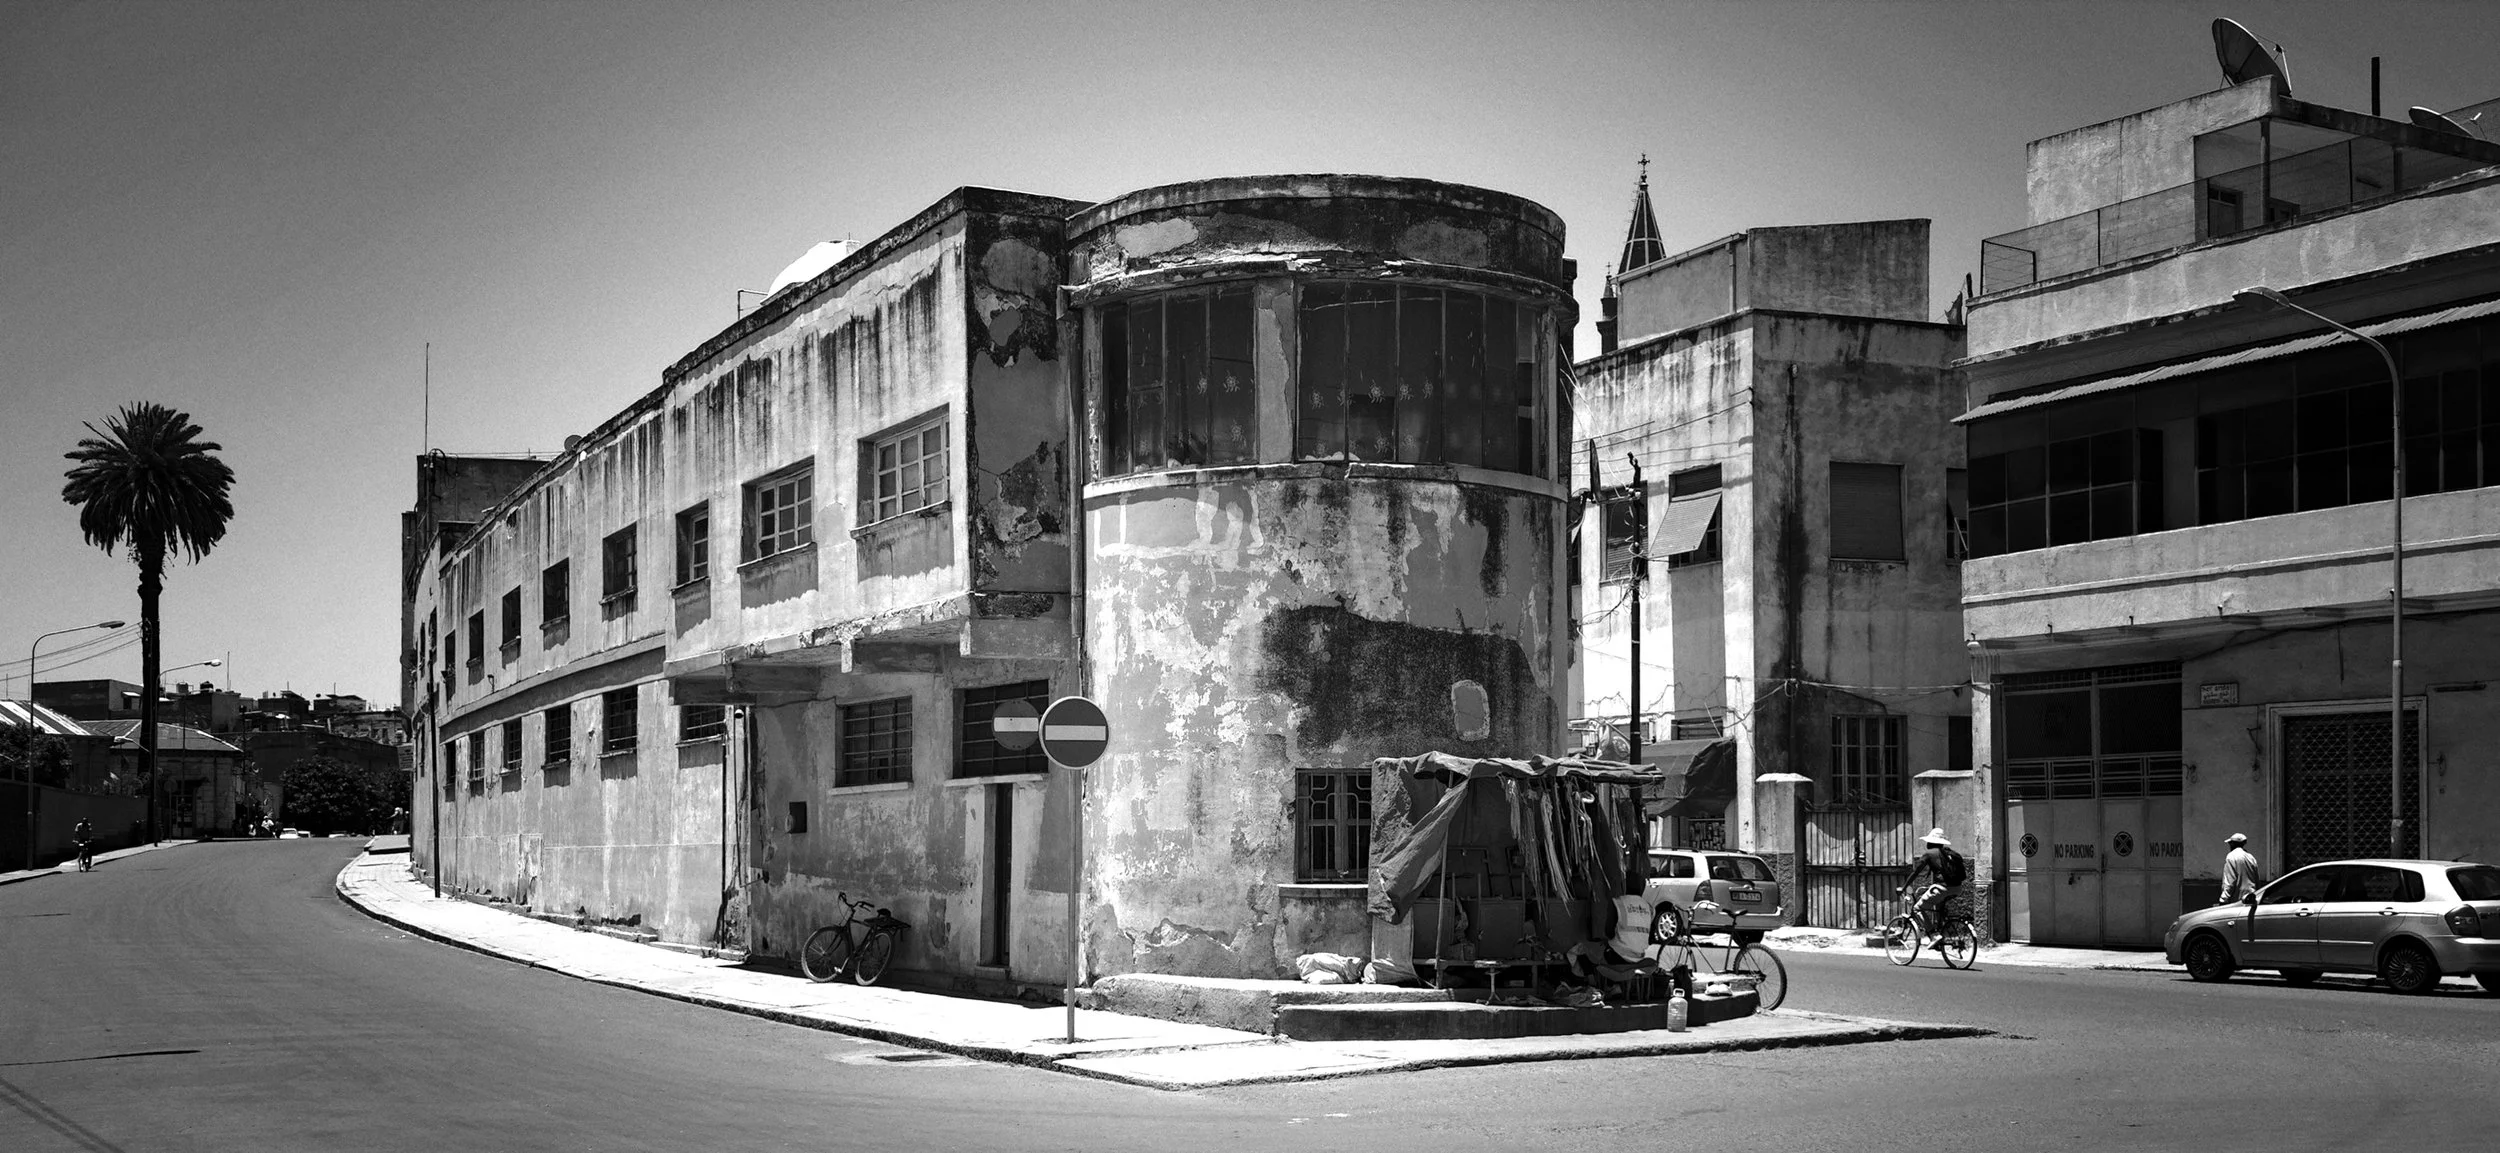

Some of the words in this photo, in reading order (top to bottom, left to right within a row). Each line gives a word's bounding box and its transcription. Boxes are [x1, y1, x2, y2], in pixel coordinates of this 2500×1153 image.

[2054, 844, 2064, 858] NO
[2065, 844, 2095, 858] PARKING
[2149, 842, 2160, 857] NO
[2161, 842, 2184, 857] PARKI
